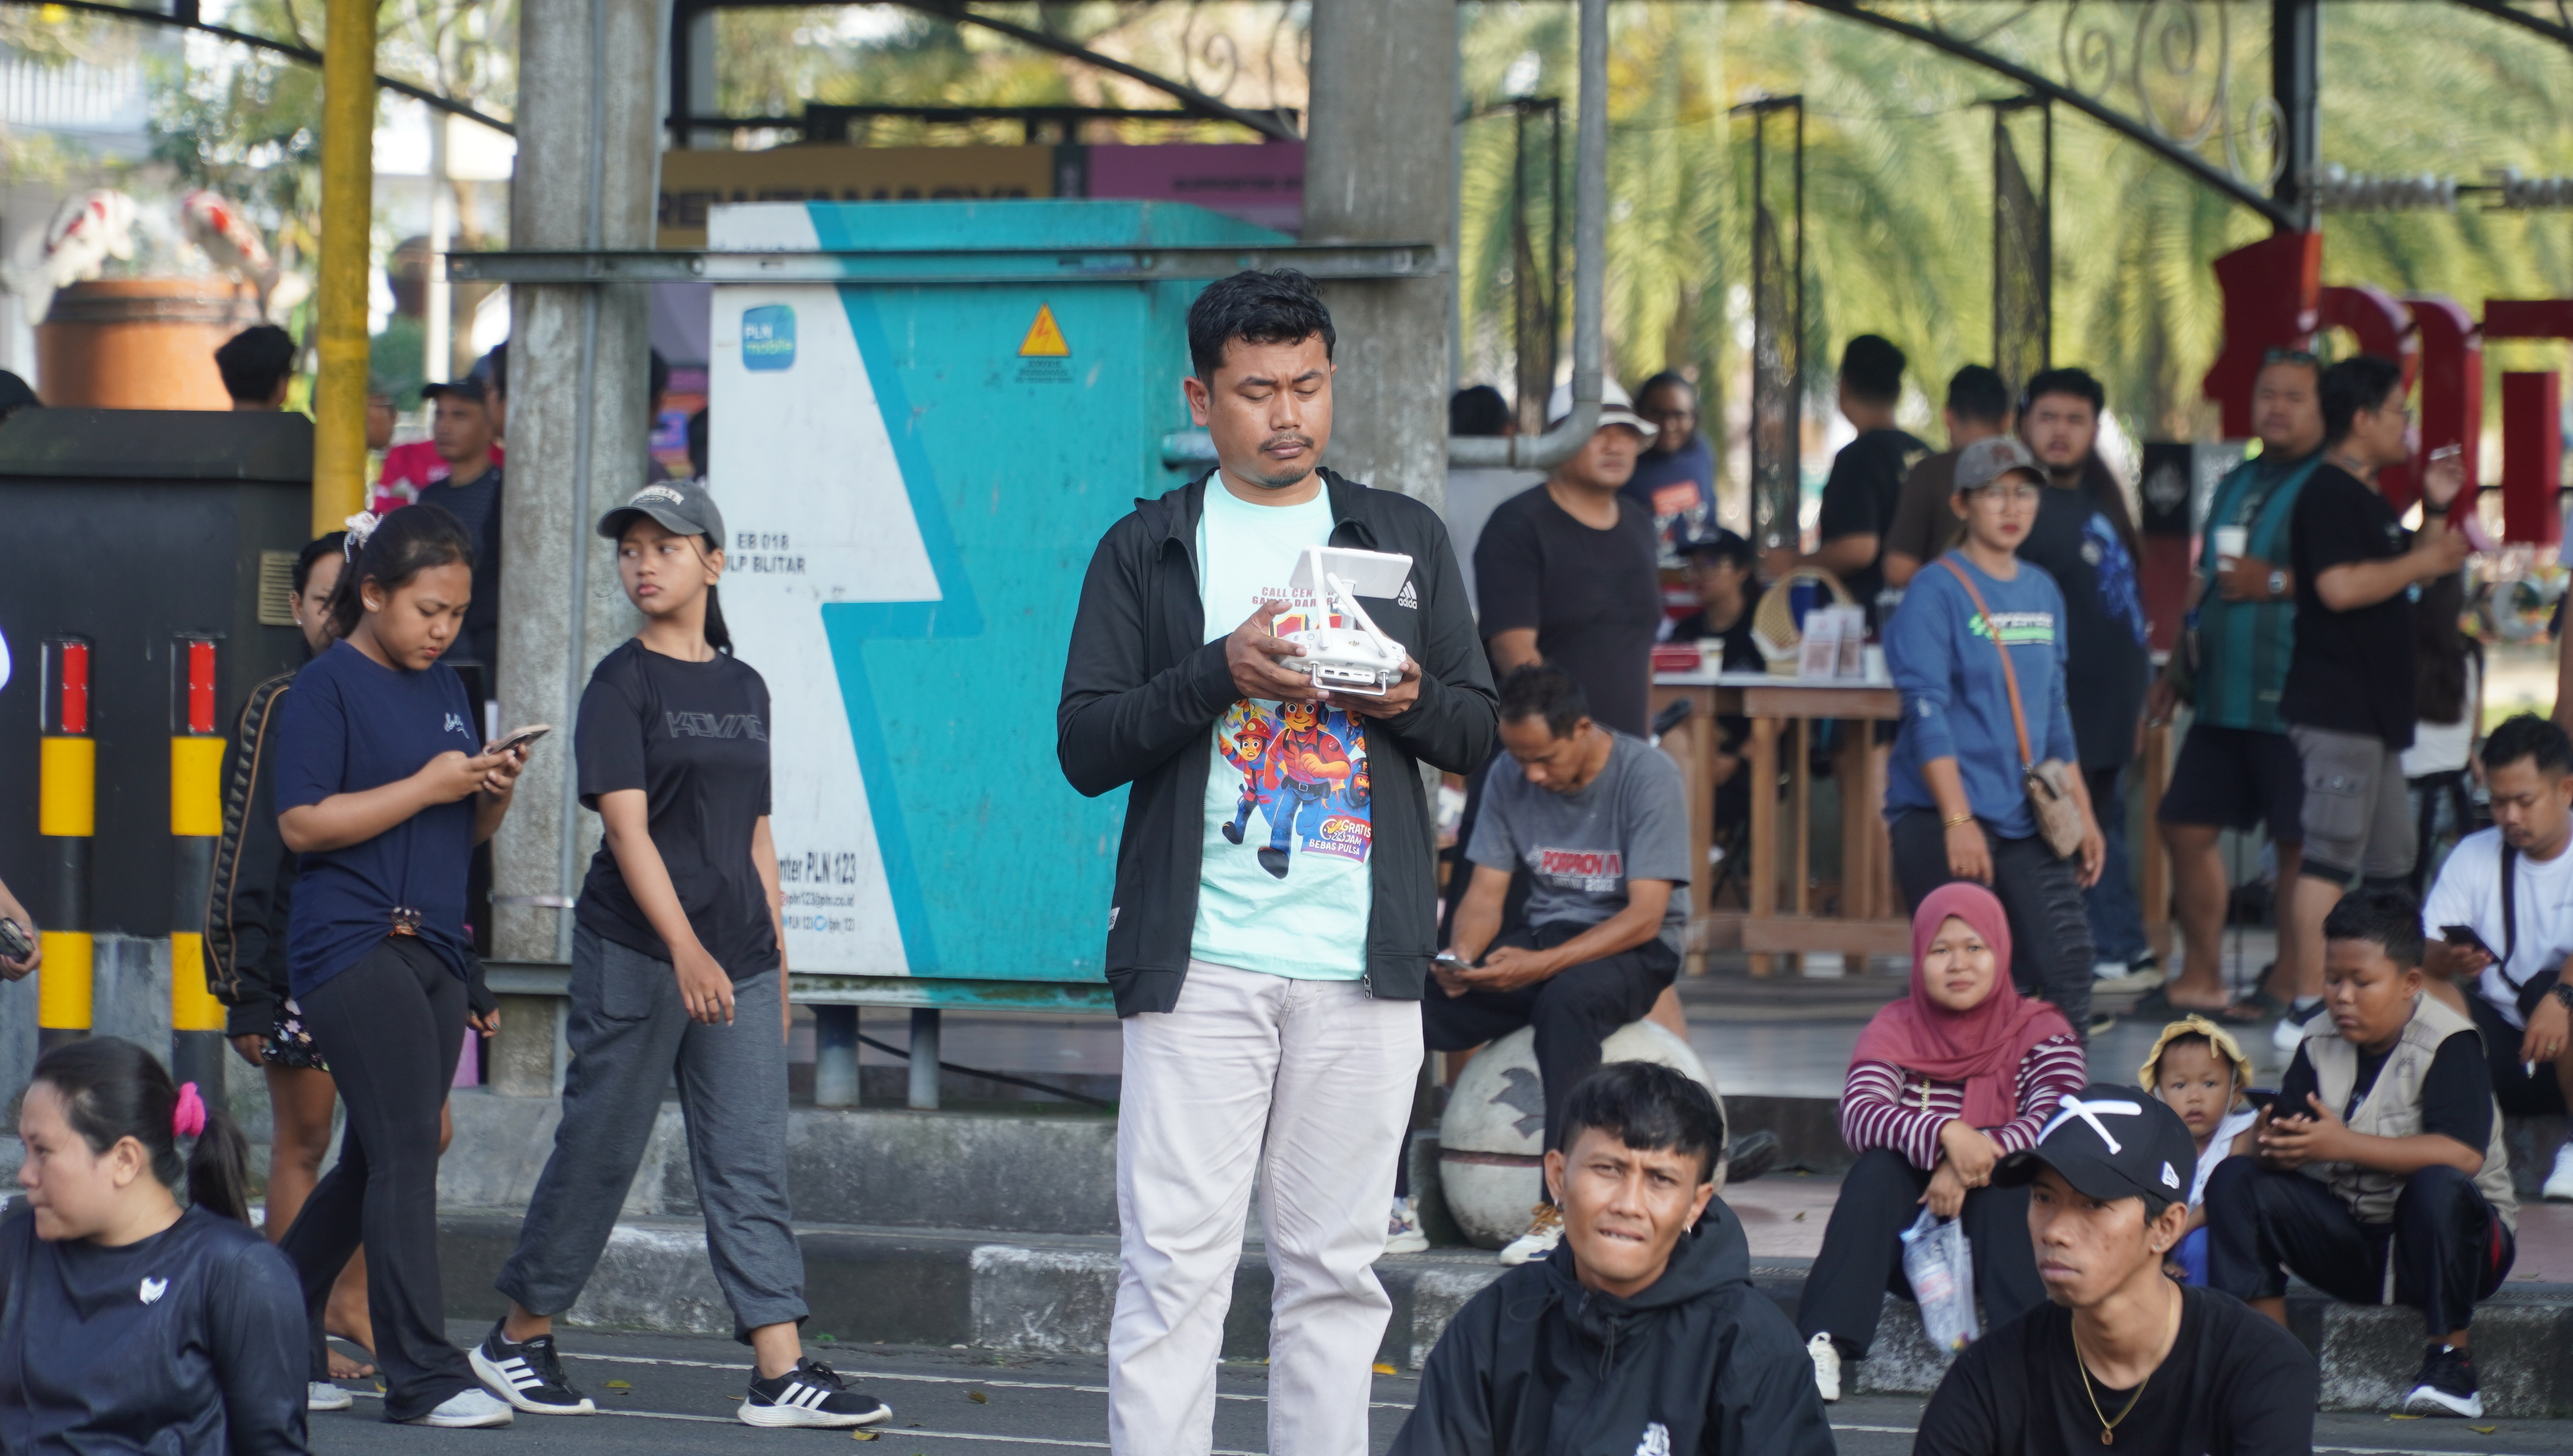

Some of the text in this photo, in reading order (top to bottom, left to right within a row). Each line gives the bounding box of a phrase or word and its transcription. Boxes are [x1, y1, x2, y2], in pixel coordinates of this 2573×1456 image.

[745, 325, 773, 339] PLN
[746, 337, 793, 355] mobile
[738, 534, 788, 550] EB 018
[754, 556, 806, 574] BLITAR
[1262, 587, 1287, 597] CALL
[1340, 820, 1371, 838] GRATIS
[1331, 831, 1362, 846] 24 JAM
[1309, 839, 1360, 855] BEBAS PULSA
[779, 852, 856, 884] nter PLN 123
